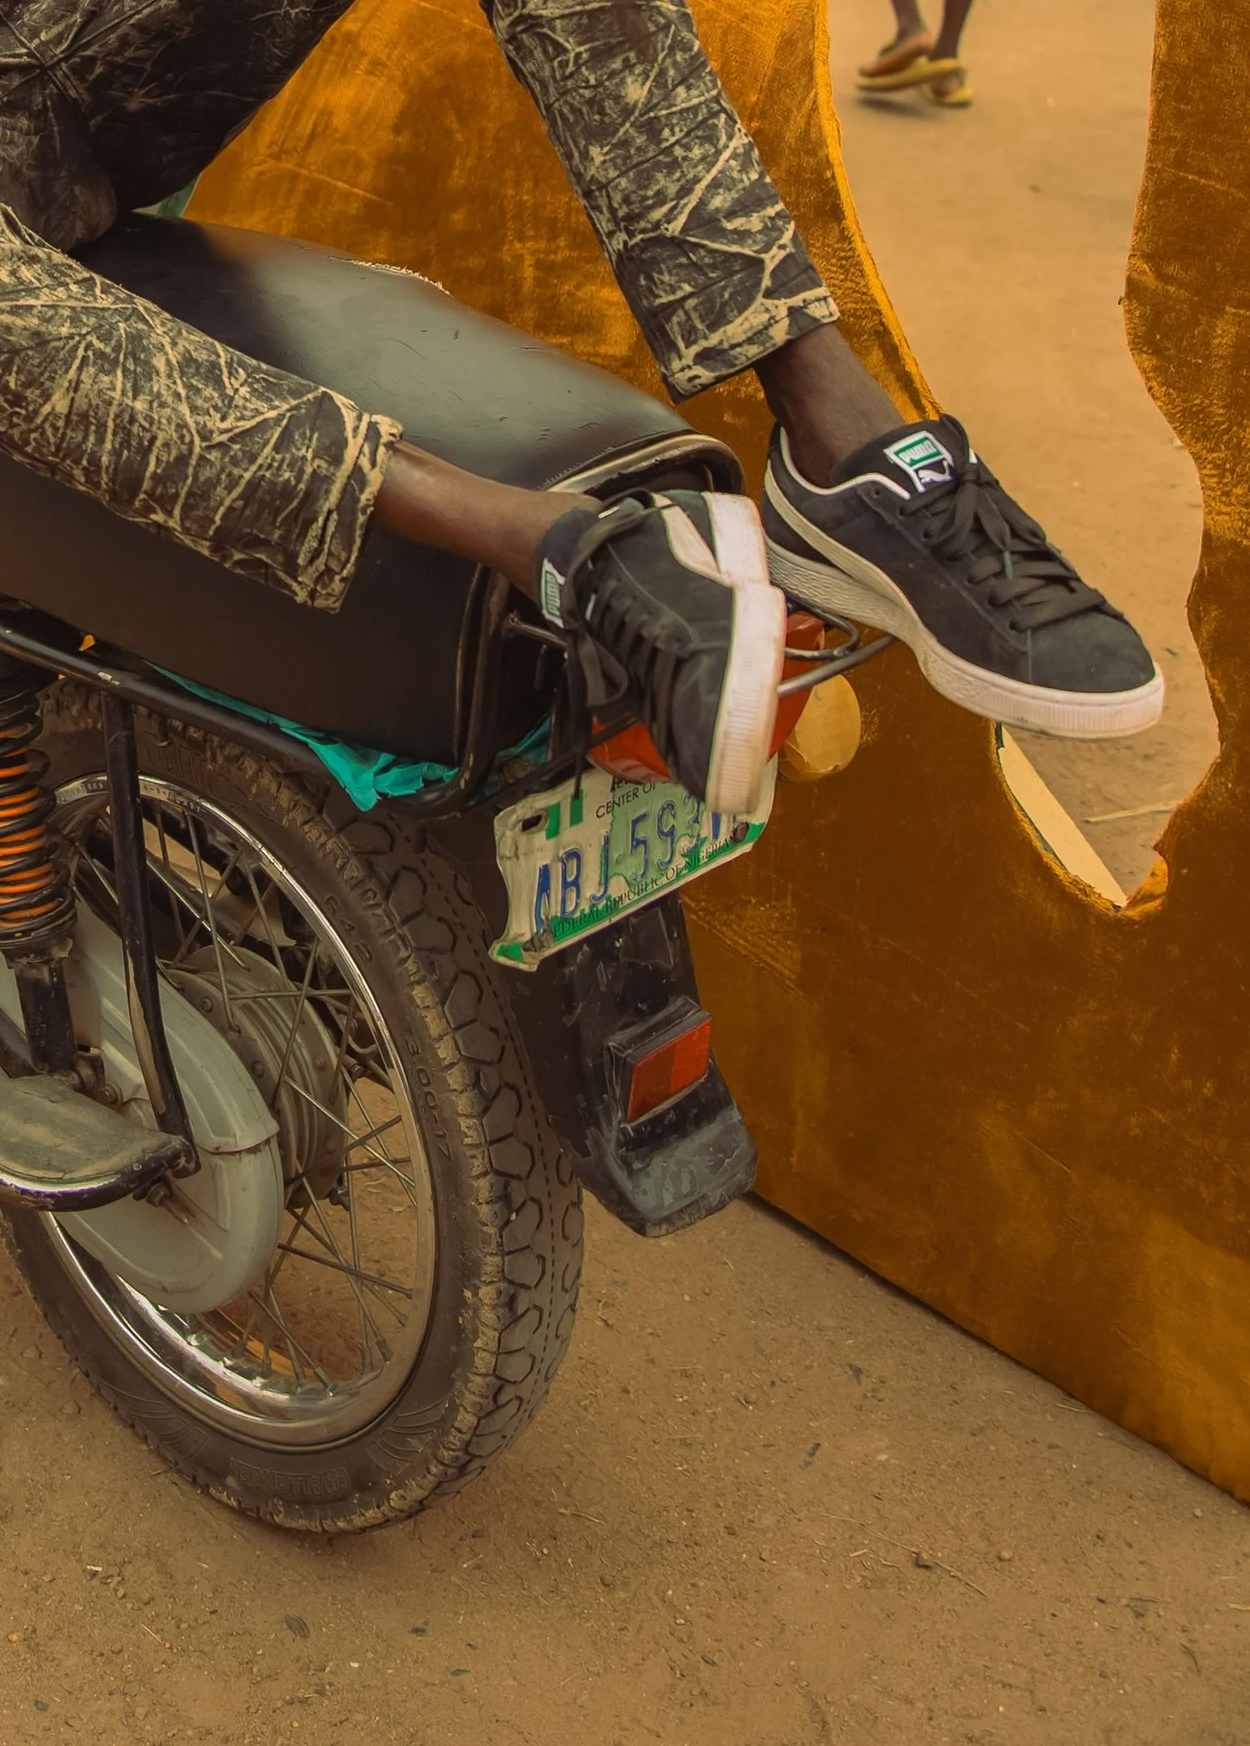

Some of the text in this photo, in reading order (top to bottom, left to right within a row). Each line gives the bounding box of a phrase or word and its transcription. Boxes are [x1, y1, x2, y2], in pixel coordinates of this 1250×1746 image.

[595, 787, 640, 819] CENTER
[554, 906, 600, 937] EDERAL
[666, 863, 682, 881] OF
